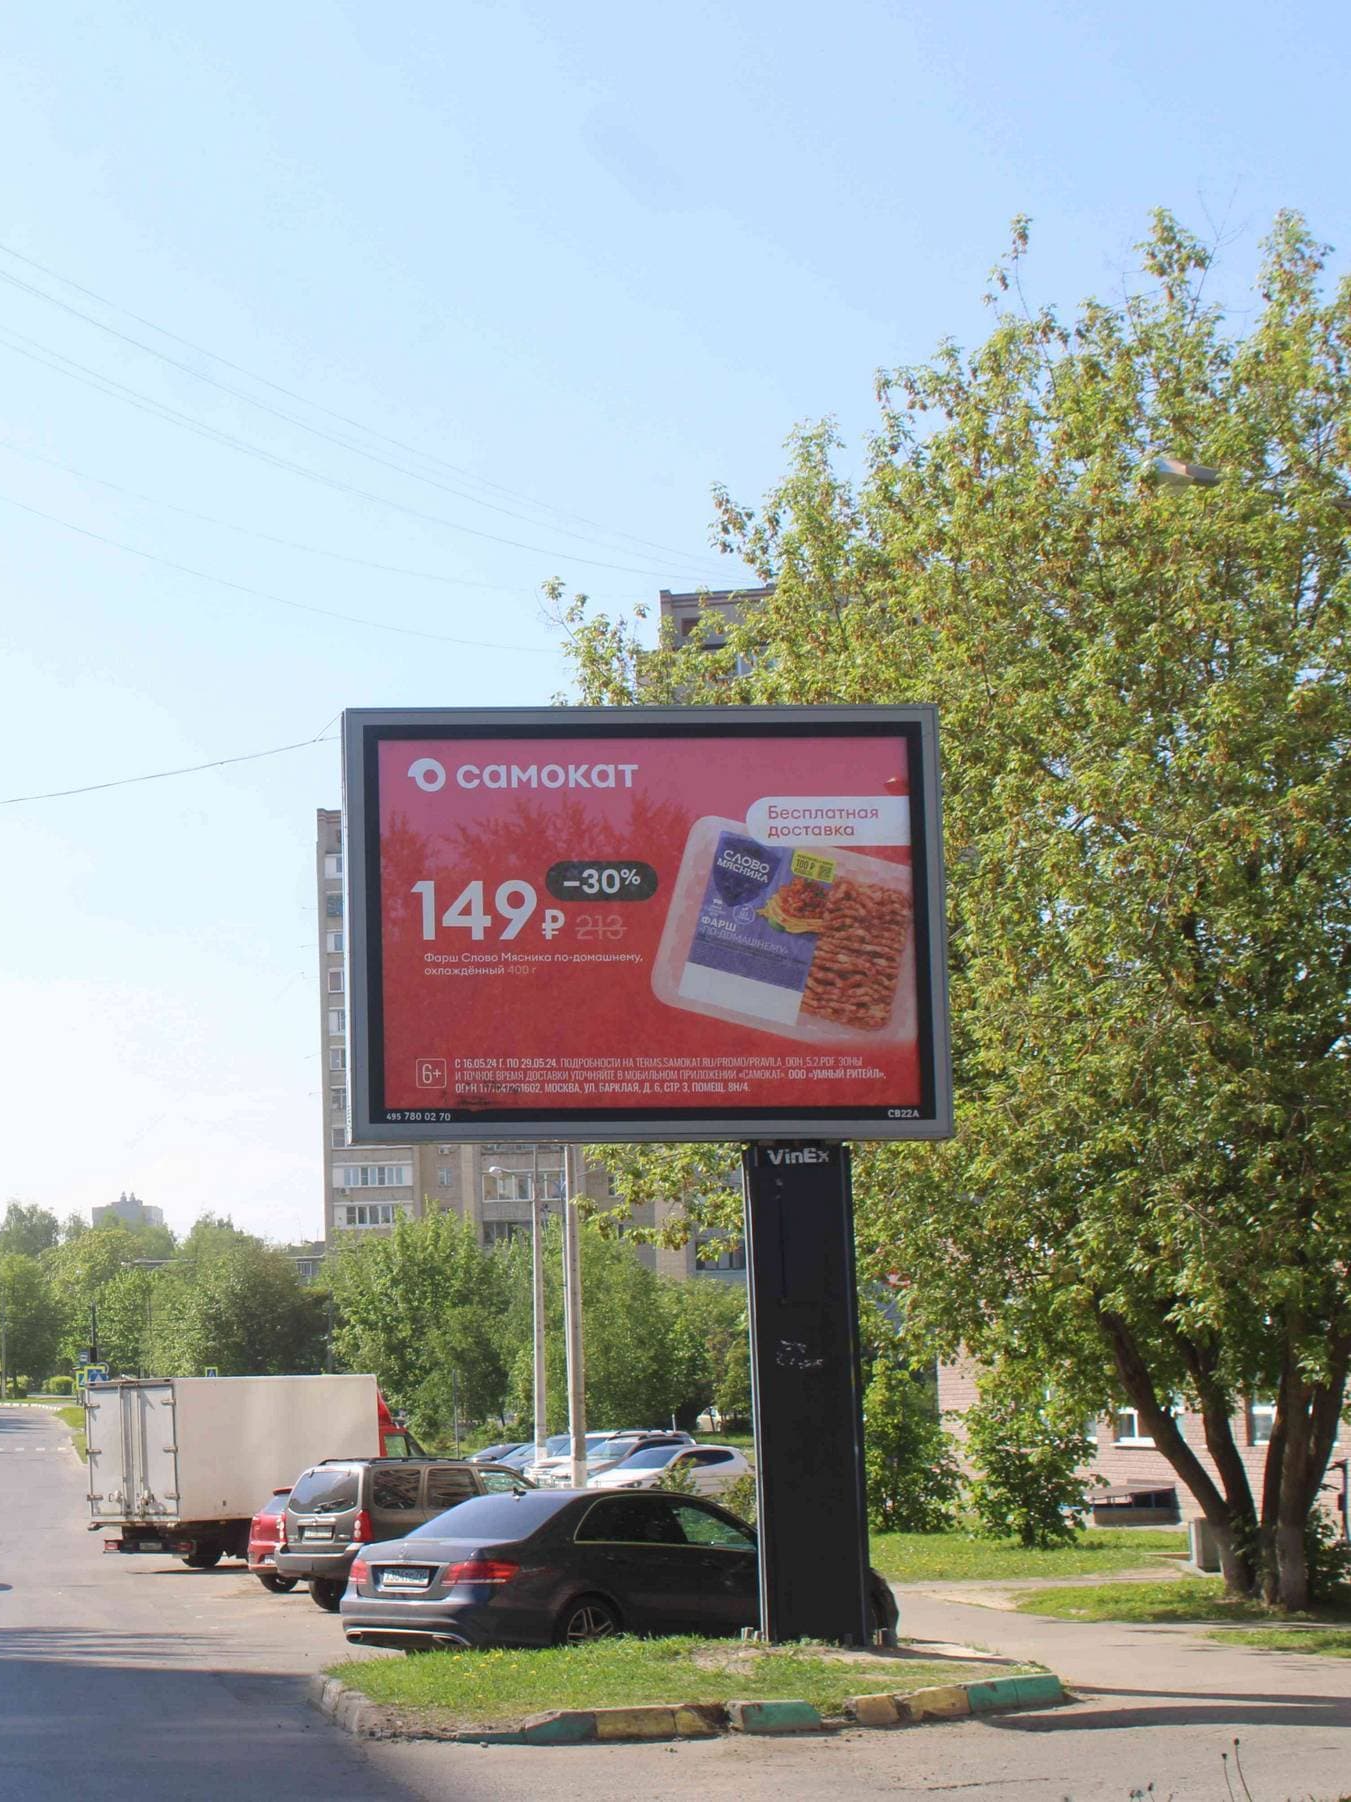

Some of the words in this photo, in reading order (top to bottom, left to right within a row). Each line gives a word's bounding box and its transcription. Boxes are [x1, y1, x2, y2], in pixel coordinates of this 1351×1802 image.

[456, 763, 639, 790] самокат
[767, 805, 879, 821] Бесплатная
[767, 824, 855, 839] доставка
[723, 849, 770, 874] СЛОВО
[716, 857, 769, 884] МЯСНИКА
[575, 914, 627, 941] 213
[701, 915, 737, 933] ФАРШ
[424, 952, 459, 964] Фарш
[461, 952, 498, 962] Слово
[501, 952, 552, 963] Мясника
[554, 953, 644, 965] по-домашнему,
[424, 965, 505, 976] охлаждённый
[507, 965, 529, 975] 400
[454, 1058, 461, 1068] С
[463, 1058, 497, 1068] 16.05.24
[507, 1058, 520, 1068] ПО
[560, 1058, 621, 1068] ПОДРОБНОСТИ
[622, 1058, 634, 1067] НА
[838, 1056, 863, 1067] ЗОНЫ
[421, 1063, 443, 1085] 6+
[455, 1071, 461, 1081] И
[463, 1071, 495, 1081] ТОЧНОЕ
[496, 1071, 524, 1081] ВРЕМЯ
[525, 1071, 568, 1081] ДОСТАВКИ
[570, 1069, 615, 1081] УТОЧНЯЙТЕ
[617, 1071, 623, 1080] В
[625, 1070, 678, 1080] МОБИЛЬНОМ
[679, 1070, 737, 1080] ПРИЛОЖЕНИИ
[787, 1070, 807, 1079] ООО
[808, 1068, 844, 1080] «УМНЫЙ
[544, 1084, 582, 1094] МОСКВА,
[584, 1083, 597, 1094] УЛ.
[599, 1082, 641, 1093] БАРКЛАЯ,
[664, 1083, 681, 1093] СТР.
[386, 1113, 402, 1121] 495
[404, 1112, 422, 1121] 780
[424, 1112, 437, 1121] 02
[438, 1112, 452, 1121] 70
[767, 1147, 830, 1165] VinEx
